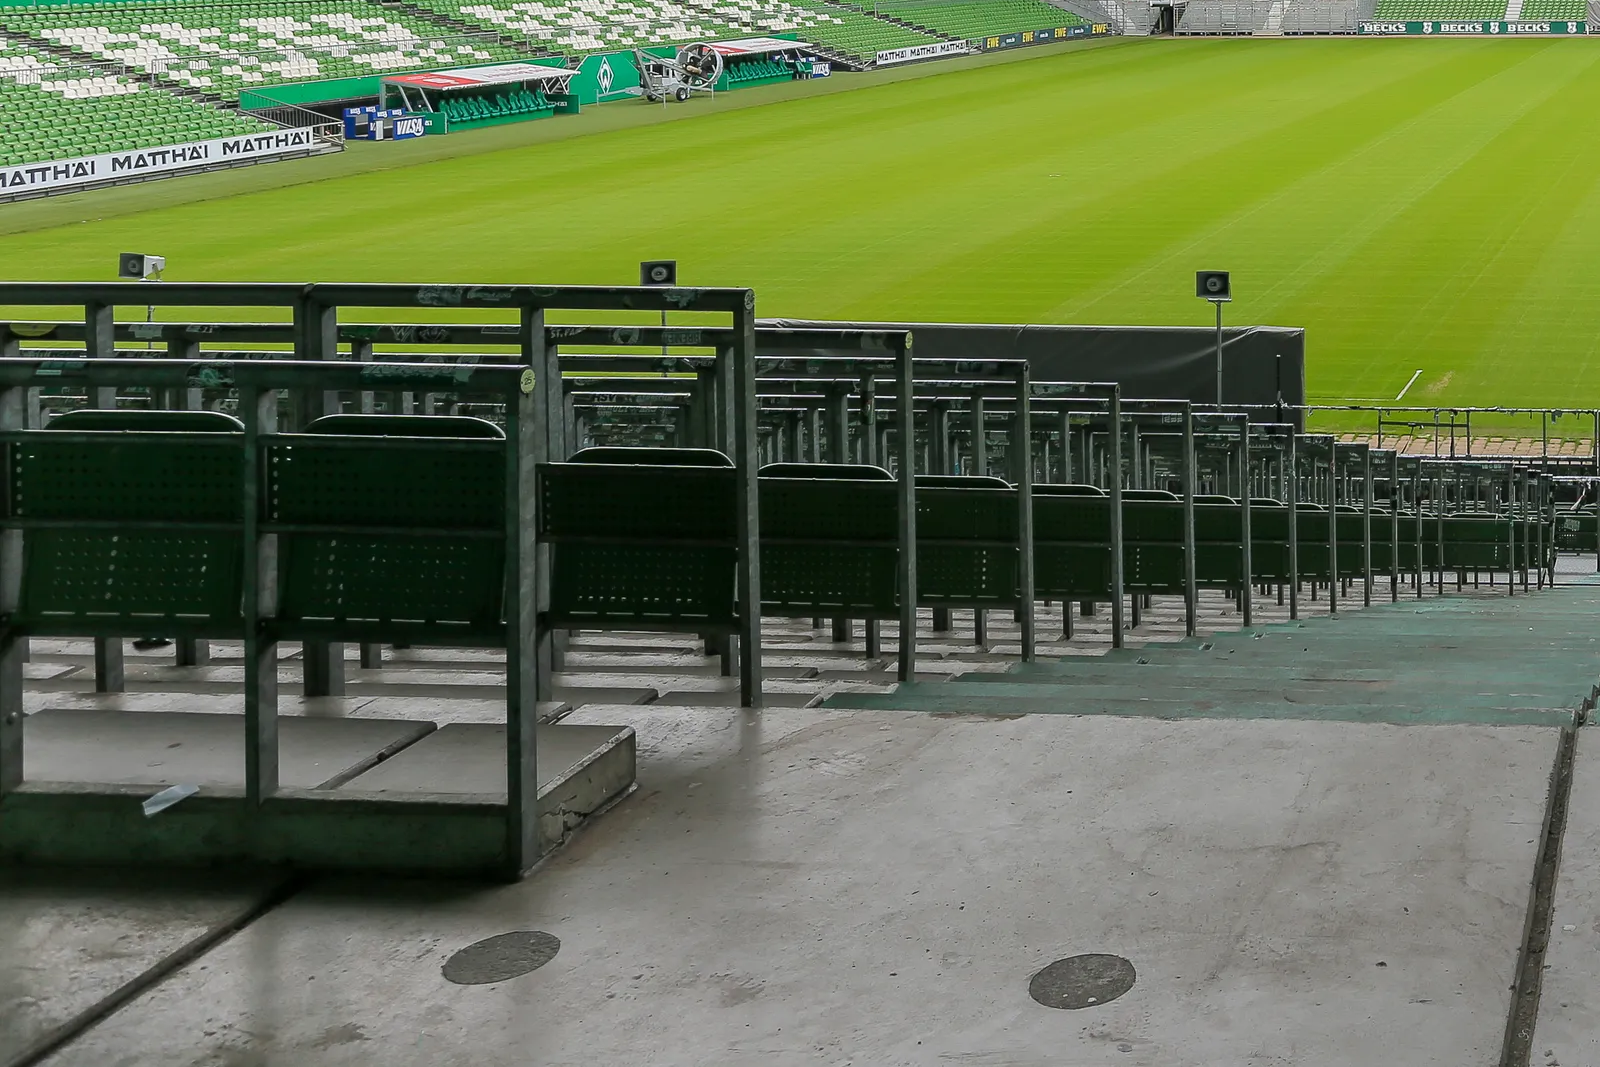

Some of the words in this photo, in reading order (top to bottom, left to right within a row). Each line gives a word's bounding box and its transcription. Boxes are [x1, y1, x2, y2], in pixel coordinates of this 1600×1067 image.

[1055, 27, 1067, 38] EWE
[1092, 23, 1107, 34] EWE
[1441, 22, 1483, 32] BECK'S
[1507, 22, 1550, 32] BECK'S
[1022, 31, 1034, 42] EWE
[987, 37, 999, 48] EWE
[396, 118, 424, 136] VILSA
[112, 144, 208, 172] MATTHÄI
[222, 127, 310, 156] MATTHÄI
